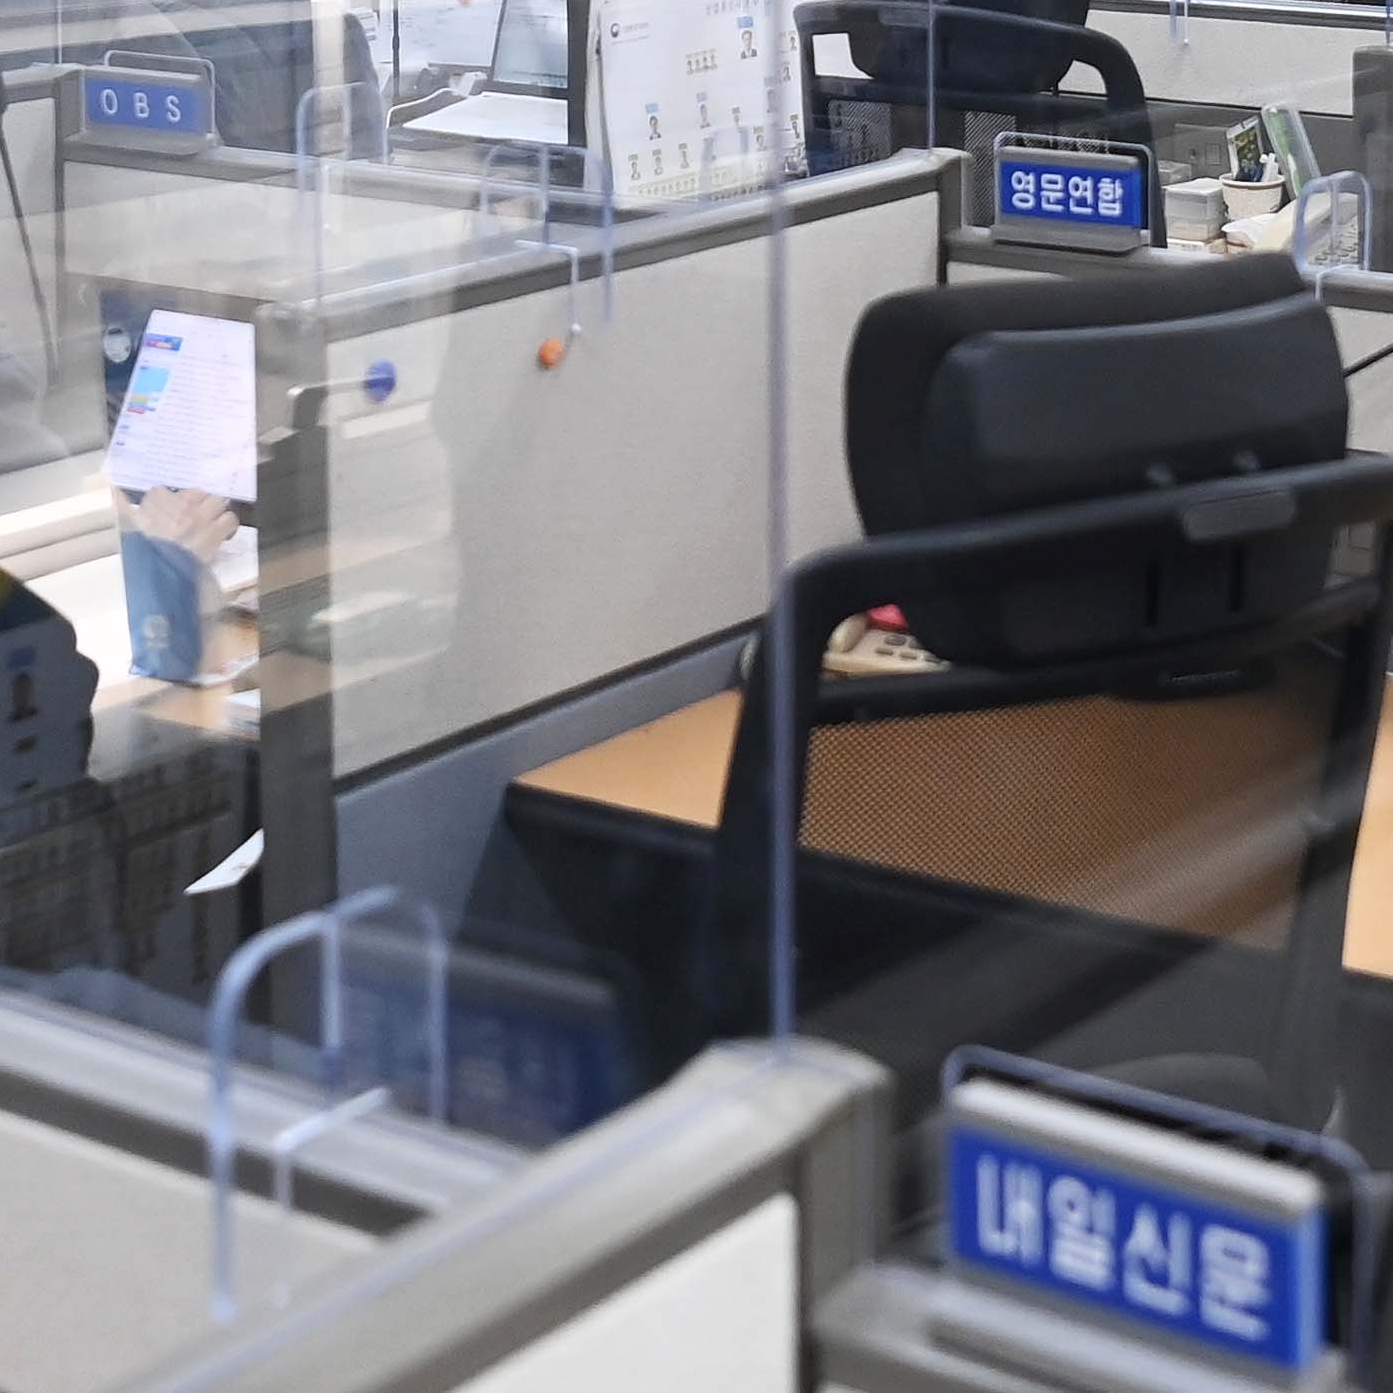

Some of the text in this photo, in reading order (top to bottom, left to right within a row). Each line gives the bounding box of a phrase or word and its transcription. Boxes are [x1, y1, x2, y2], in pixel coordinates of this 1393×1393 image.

[100, 88, 182, 123] OBS
[1011, 170, 1124, 217] 영문연합
[976, 1154, 1273, 1341] 내일신문
